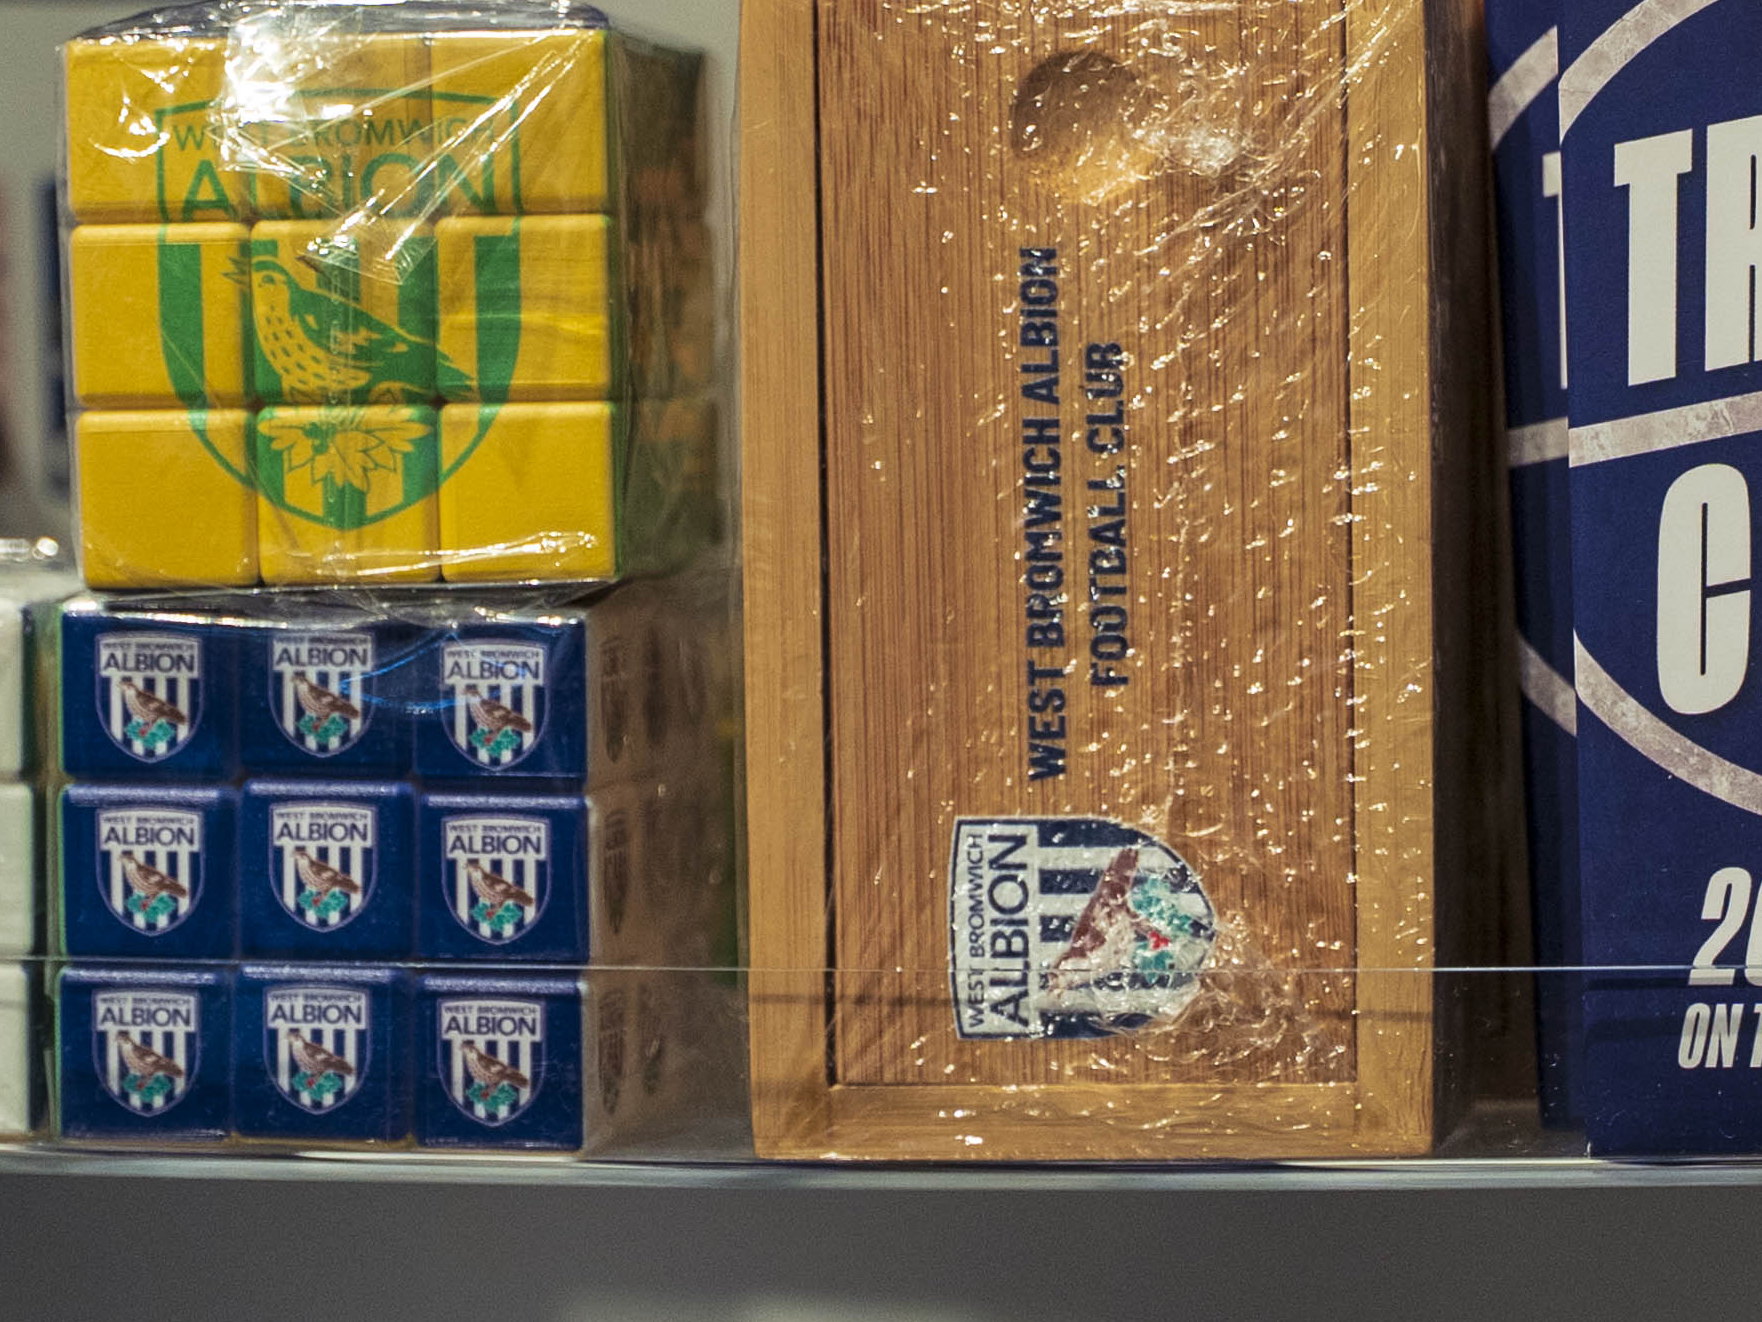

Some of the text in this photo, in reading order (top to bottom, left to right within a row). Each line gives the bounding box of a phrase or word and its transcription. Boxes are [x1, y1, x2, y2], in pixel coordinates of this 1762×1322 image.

[1019, 246, 1067, 781] WEST BROMWICH ALBION
[1086, 341, 1129, 687] FOOTBALL CLUB
[103, 652, 196, 674] ALBION
[275, 646, 368, 668] ALBION
[445, 659, 541, 681] ALBION
[102, 825, 195, 848] ALBION
[275, 821, 368, 843] ALBION
[446, 834, 542, 856] ALBION
[967, 833, 986, 1029] WEST BROMWICH
[987, 834, 1030, 1028] ALBION
[99, 1005, 192, 1028] ALBION
[270, 1002, 363, 1024] ALBION
[441, 1015, 537, 1037] ALBION
[1677, 1002, 1744, 1070] ON
